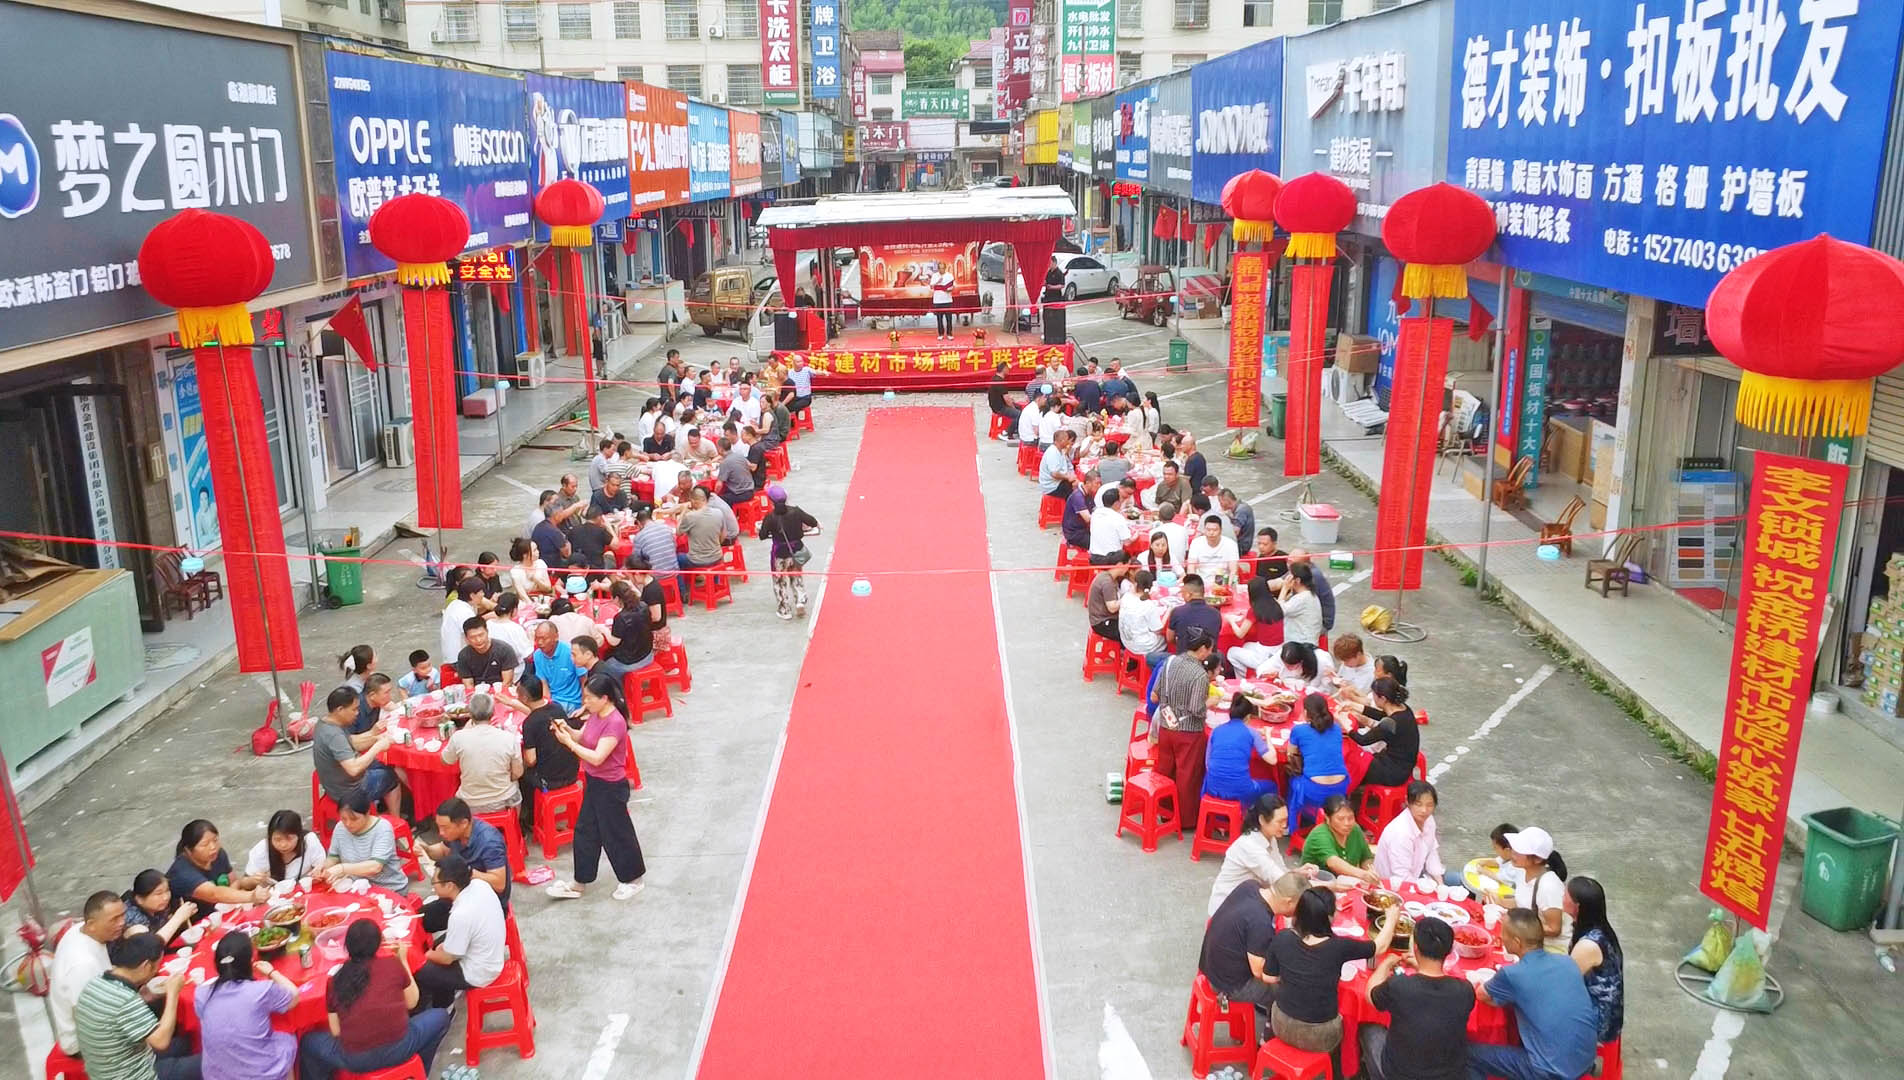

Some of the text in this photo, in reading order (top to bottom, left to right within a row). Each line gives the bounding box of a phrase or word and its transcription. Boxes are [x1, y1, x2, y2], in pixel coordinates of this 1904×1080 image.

[1012, 32, 1030, 75] 立邦
[350, 116, 432, 165] OPPLE
[50, 119, 289, 218] 梦之圆木门
[1465, 156, 1505, 193] 背景墙
[1511, 159, 1594, 200] 碳晶木饰面
[1602, 163, 1645, 204] 方通
[1720, 165, 1809, 219] 护墙板
[1487, 199, 1572, 244] 种装饰线条
[460, 264, 512, 279] 安全灶
[1523, 344, 1545, 487] 中国板材十大
